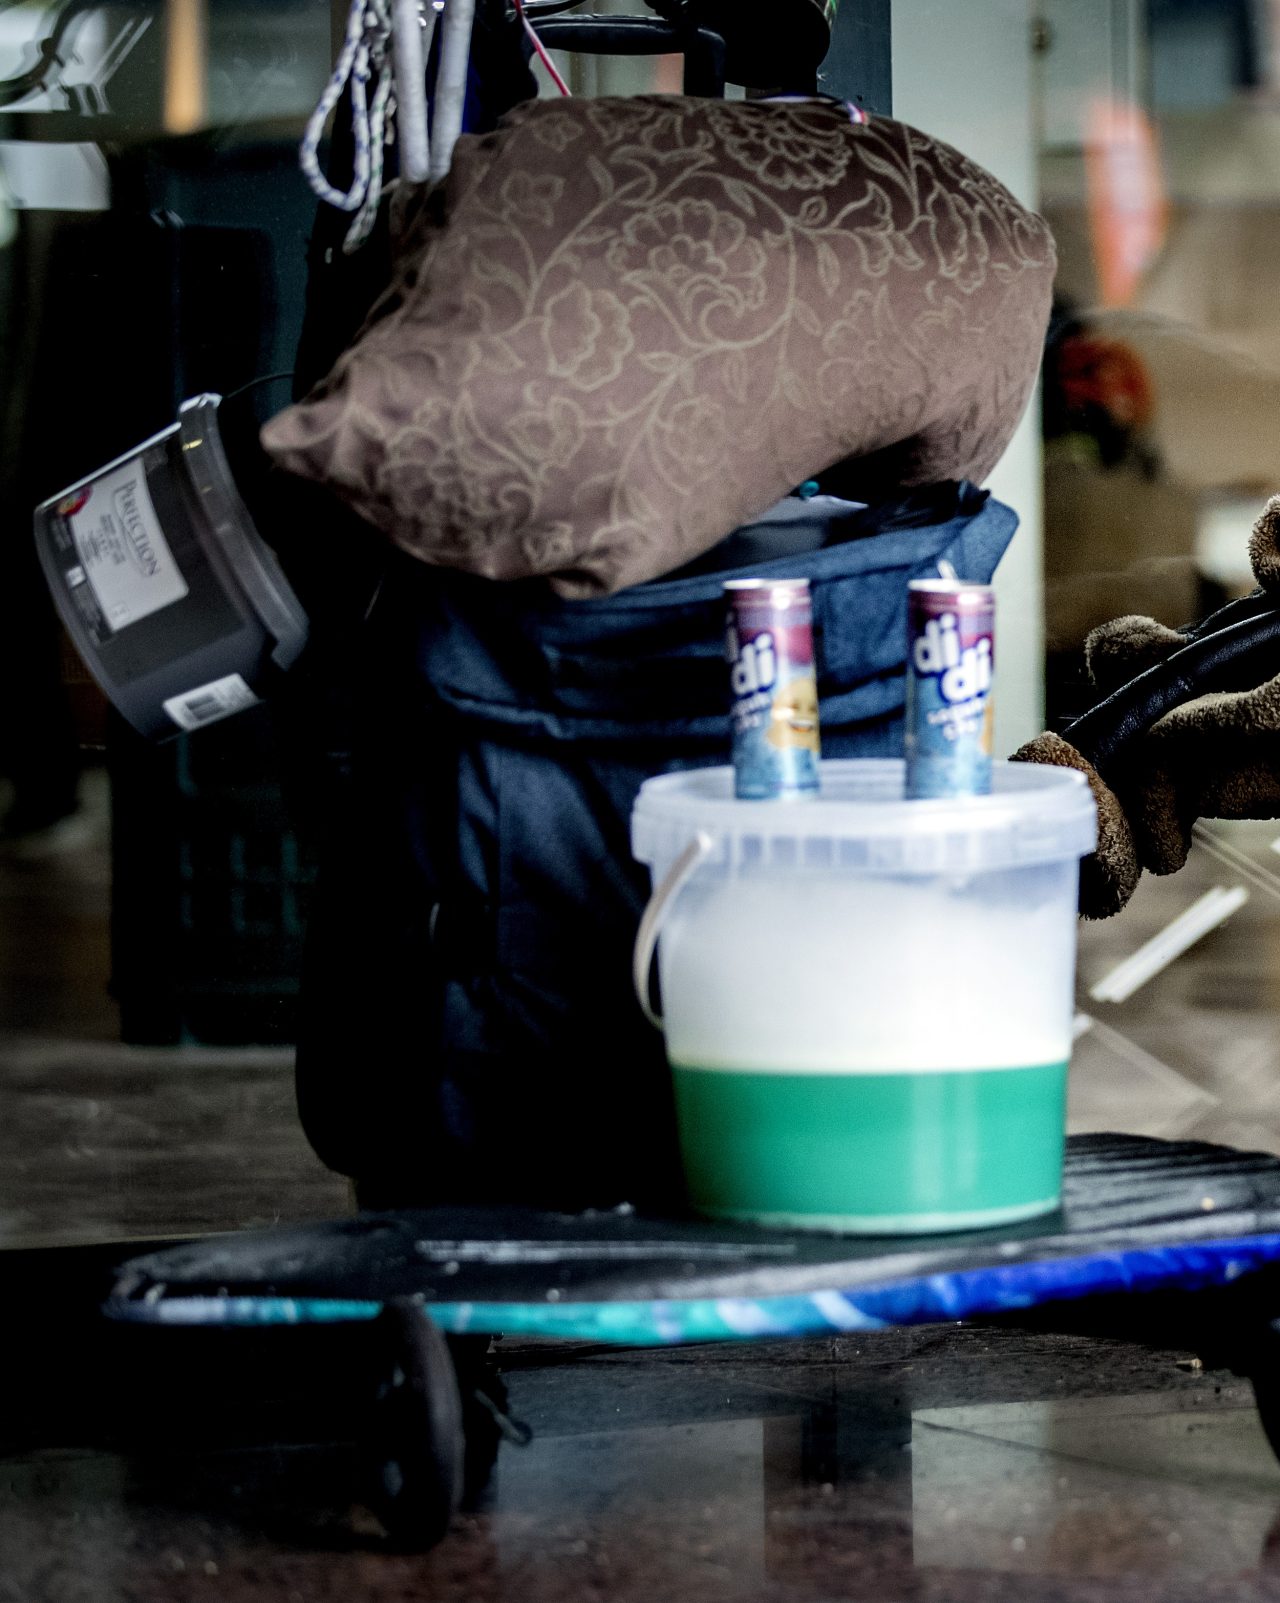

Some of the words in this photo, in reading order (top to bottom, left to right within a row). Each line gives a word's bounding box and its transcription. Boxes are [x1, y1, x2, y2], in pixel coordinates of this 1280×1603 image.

[113, 479, 161, 577] PERFECTION
[731, 633, 772, 694] di
[914, 613, 958, 672] di
[941, 638, 990, 700] di
